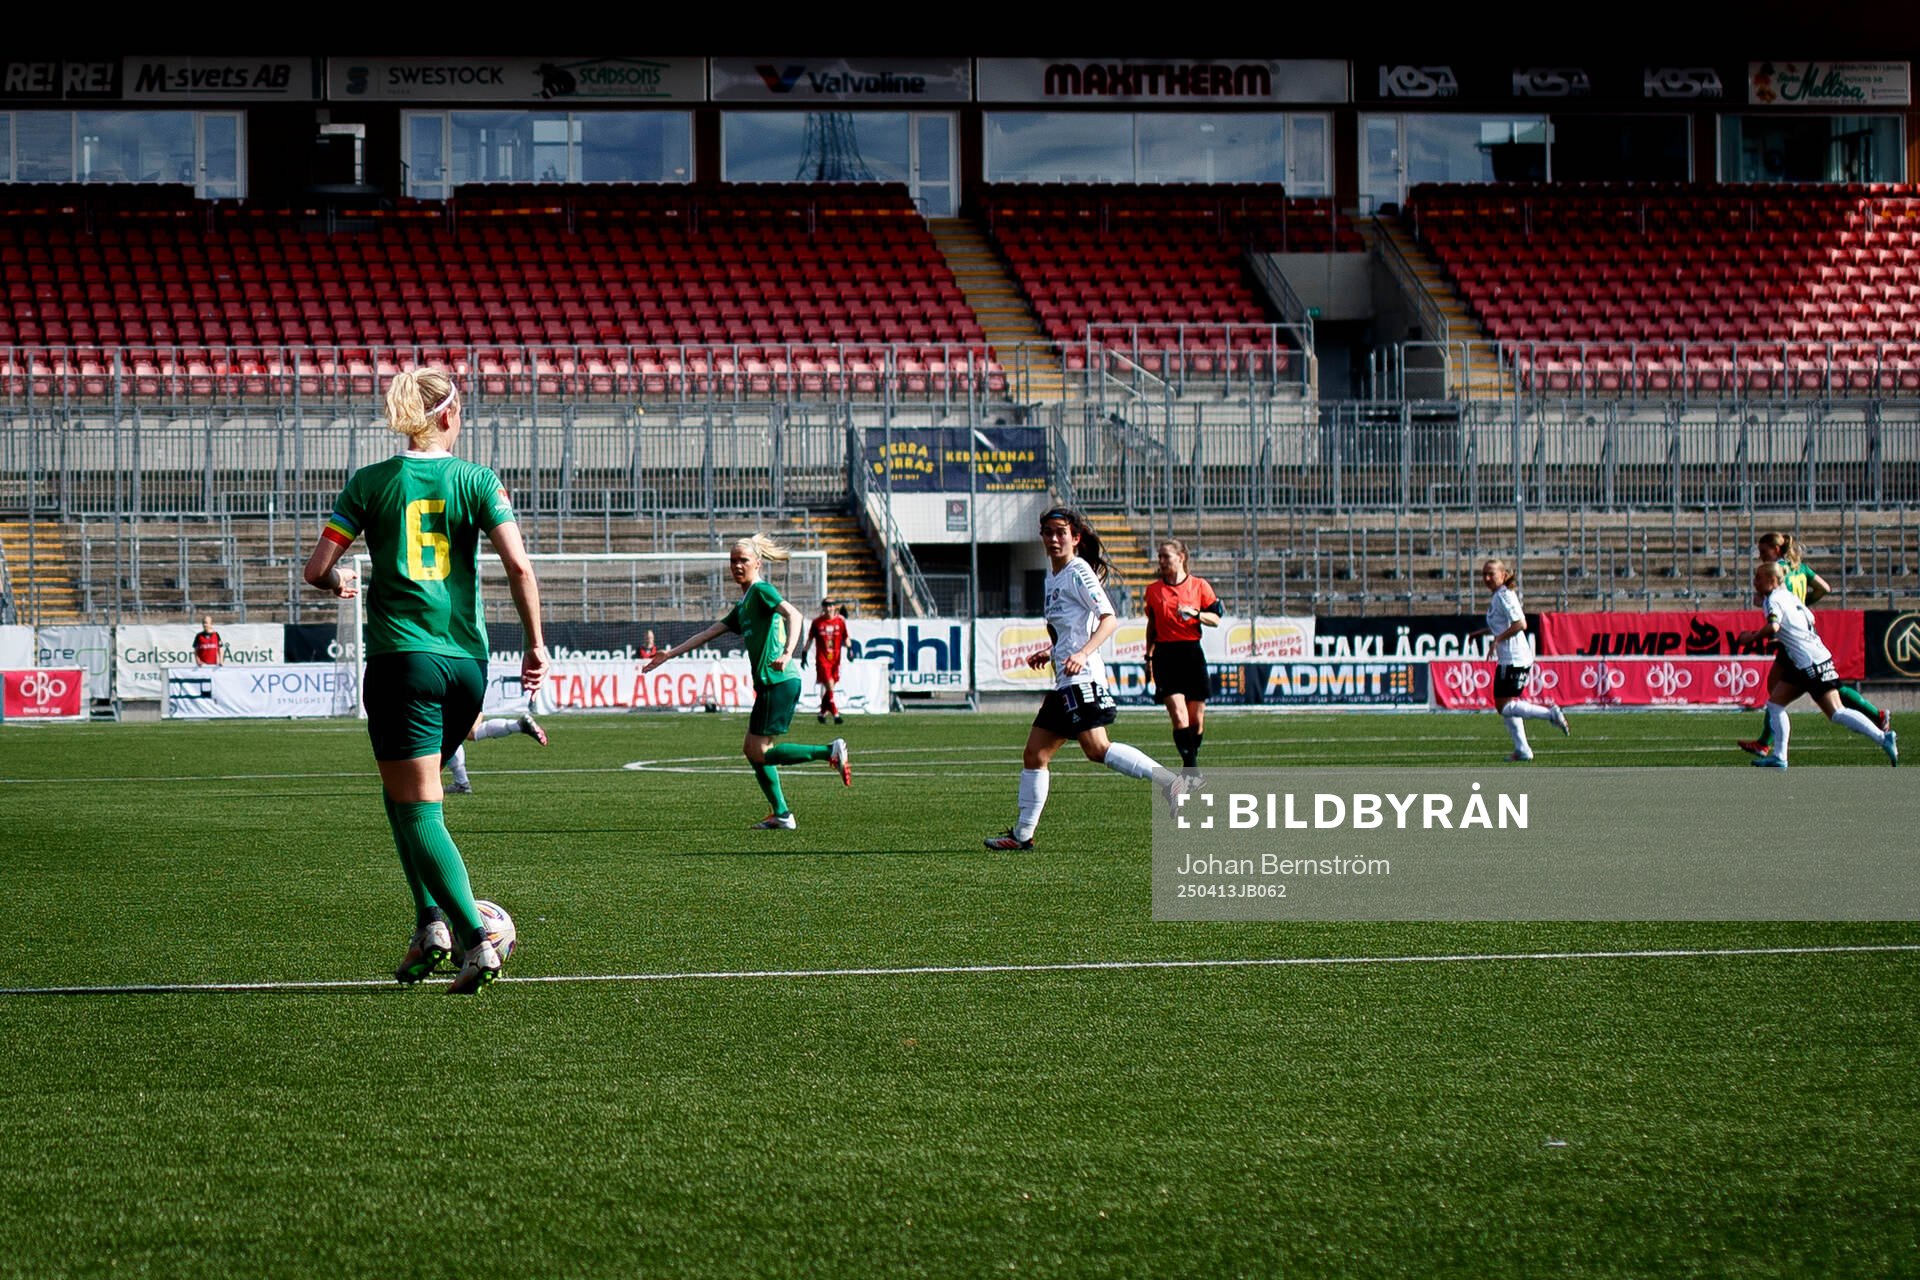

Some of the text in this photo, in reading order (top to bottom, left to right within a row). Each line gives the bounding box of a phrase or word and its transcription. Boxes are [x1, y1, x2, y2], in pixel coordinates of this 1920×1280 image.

[5, 63, 56, 92] RE!
[65, 62, 115, 91] RE!
[135, 64, 290, 92] M-svets AB
[389, 66, 503, 85] SWESTOCK
[579, 67, 660, 84] SCADSONS
[807, 71, 926, 93] Valvoline
[1044, 63, 1272, 95] MAXITHERM
[968, 462, 1012, 474] EBAB
[406, 499, 451, 581] 6
[223, 642, 273, 664] Åqvist
[1315, 626, 1536, 656] TAKLÄGGAR
[1576, 633, 1681, 655] JUMP
[20, 671, 67, 705] ÖBO
[549, 666, 757, 707] TAKLÄGGAR
[1264, 665, 1387, 696] ADMIT
[1444, 662, 1490, 696] ÖBO
[1581, 661, 1625, 696] ÖBO
[1646, 662, 1692, 696] ÖBO
[1713, 661, 1760, 696] ÖBO
